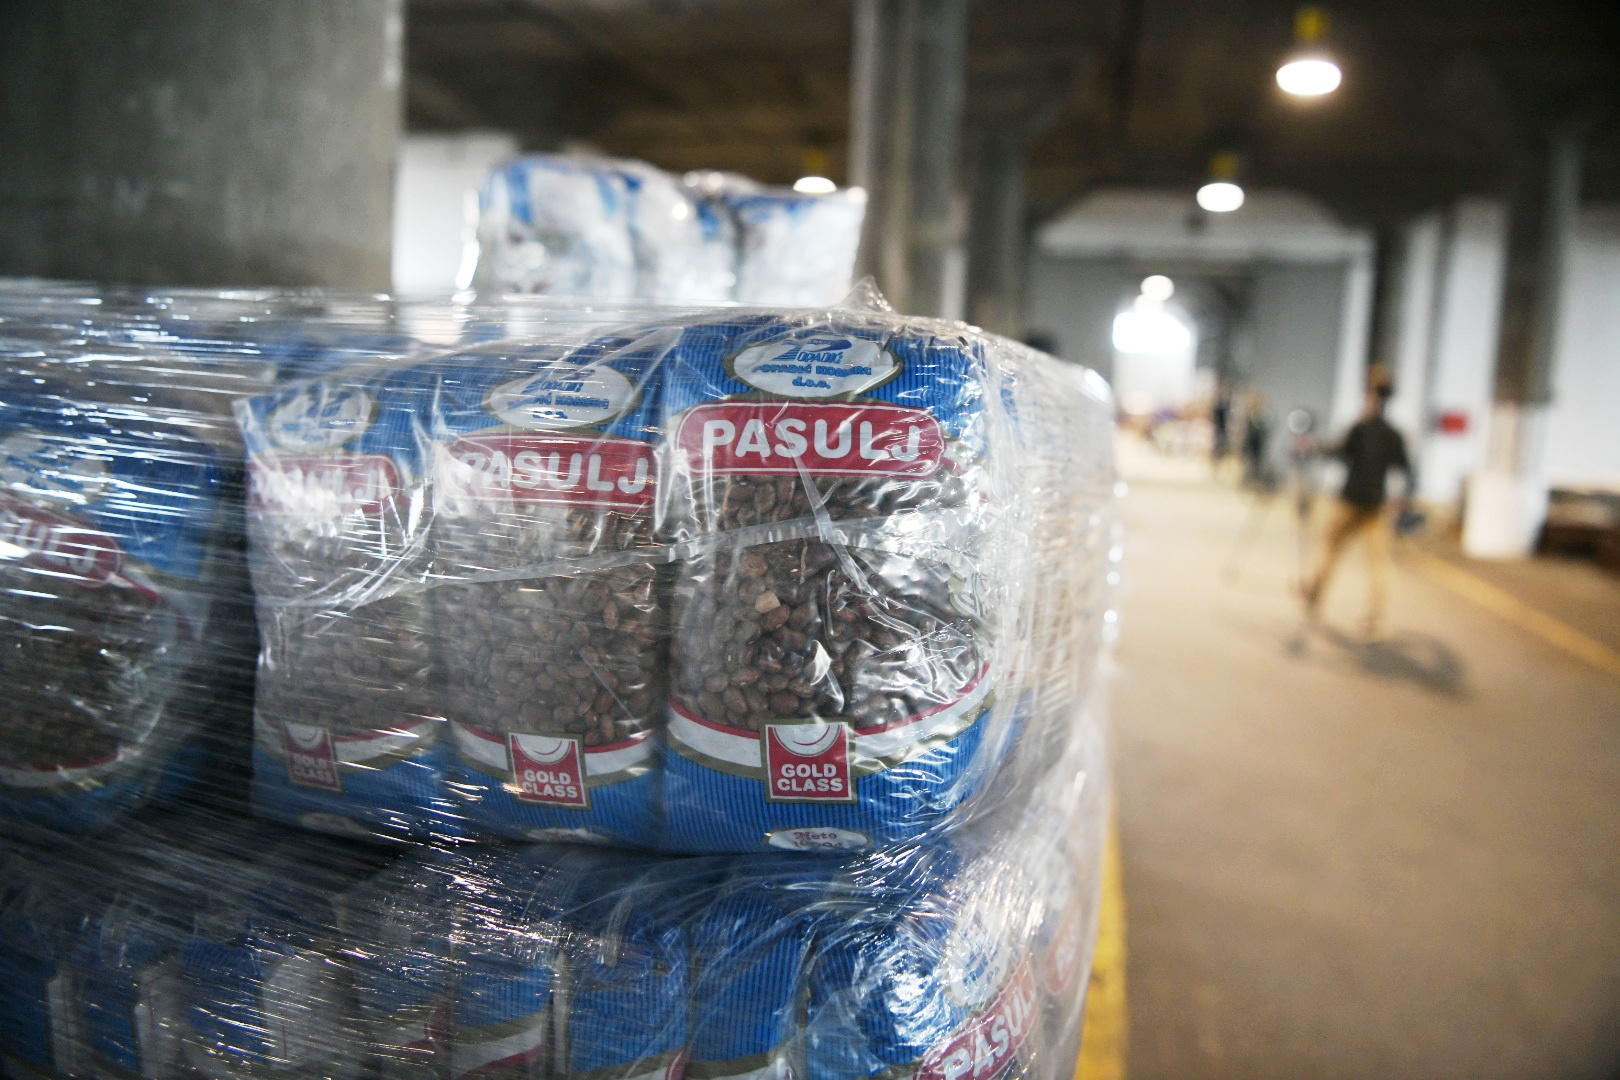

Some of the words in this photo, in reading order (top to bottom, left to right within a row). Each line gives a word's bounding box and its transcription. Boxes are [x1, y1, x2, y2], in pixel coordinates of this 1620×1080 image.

[702, 418, 921, 462] PASULJ
[524, 769, 572, 785] GOLD
[781, 763, 837, 778] GOLD
[521, 781, 578, 799] CLASS
[777, 777, 843, 792] CLASS
